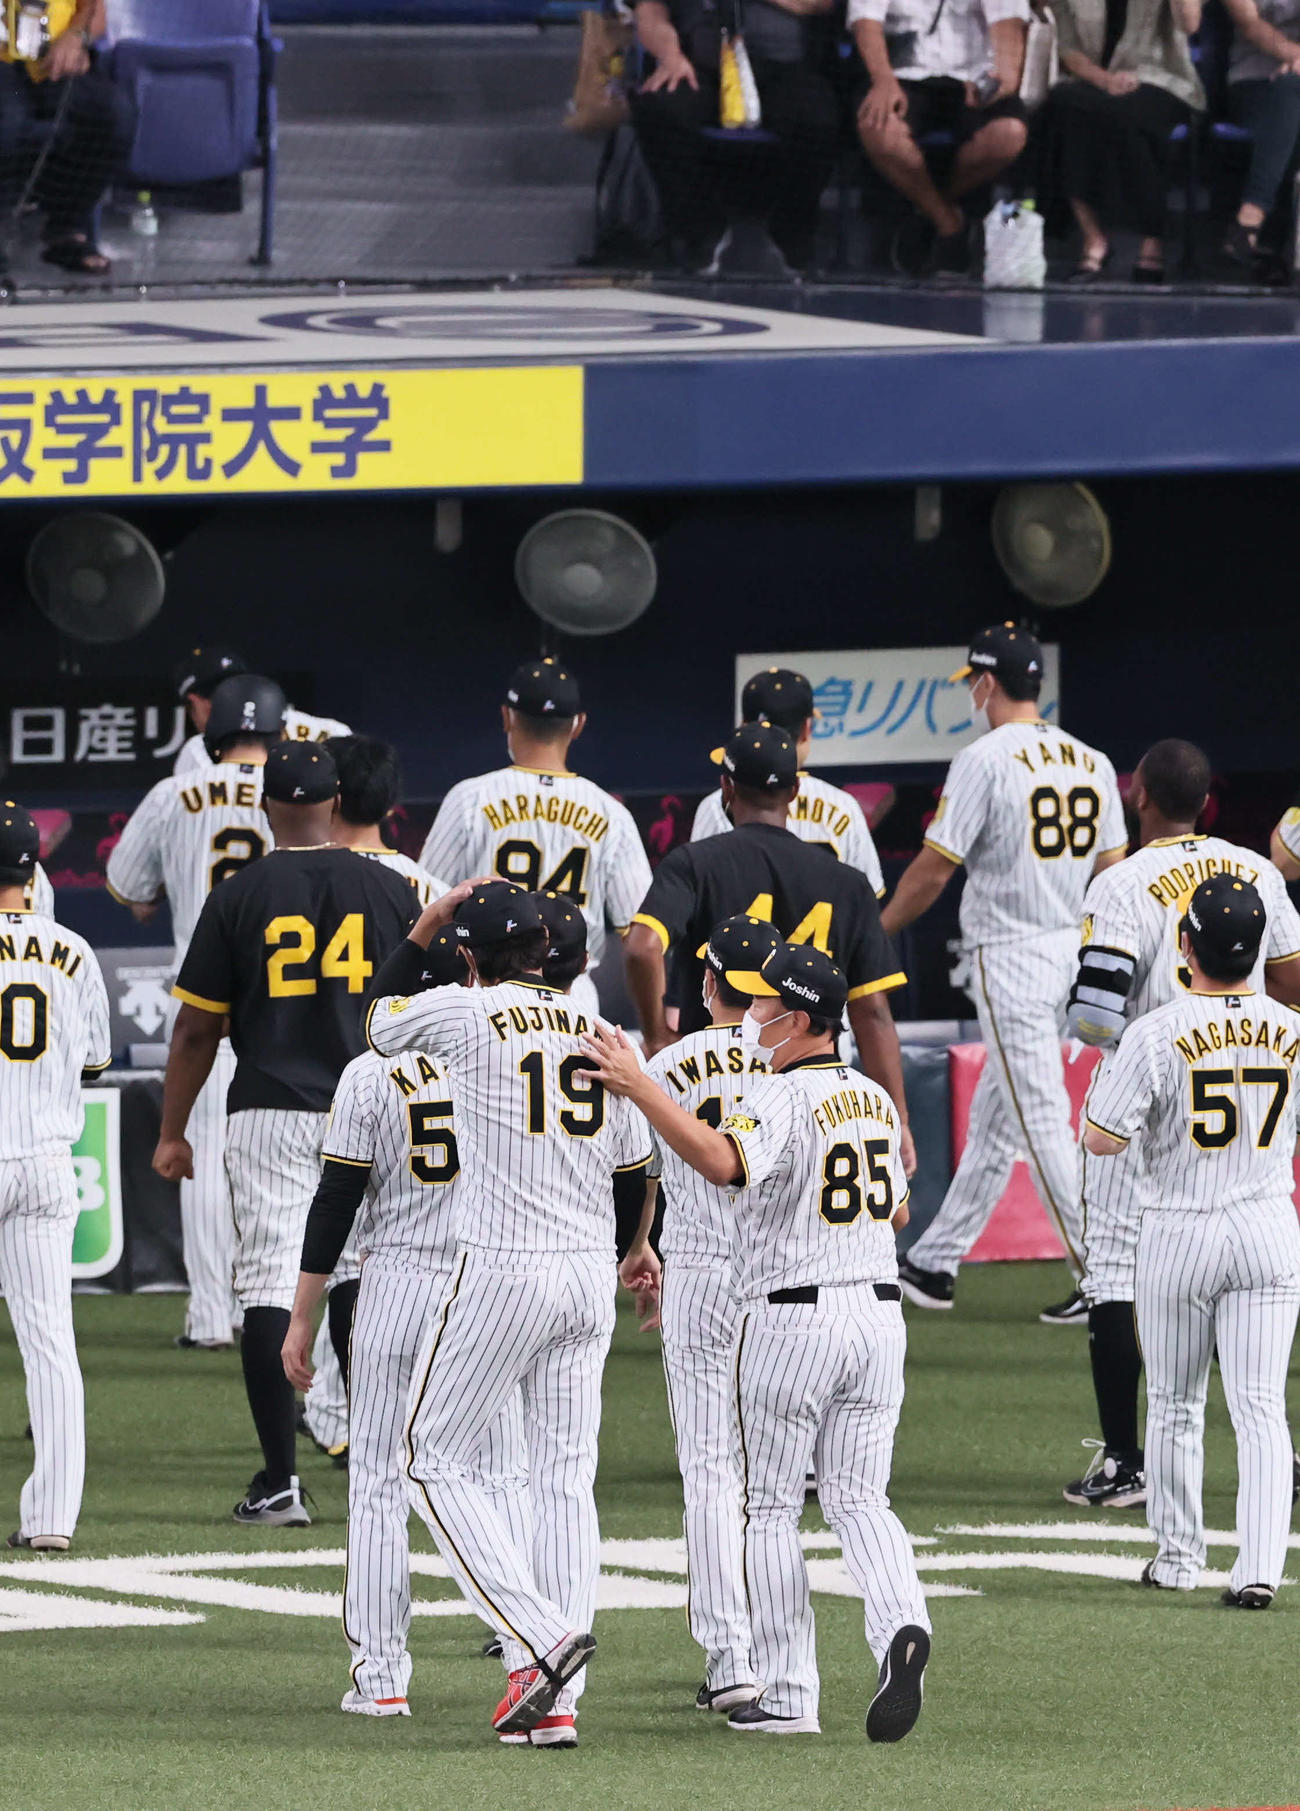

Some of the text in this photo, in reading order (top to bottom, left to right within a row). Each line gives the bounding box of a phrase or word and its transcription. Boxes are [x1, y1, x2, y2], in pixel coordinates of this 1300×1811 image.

[11, 703, 187, 764] 日産リ
[1013, 741, 1096, 775] YANO
[181, 781, 265, 814] UME
[482, 795, 609, 842] HARAGUCHI
[785, 794, 850, 837] MOTO
[1030, 786, 1101, 859] 88
[210, 826, 267, 890] 2
[495, 838, 590, 907] 94
[264, 913, 373, 998] 24
[781, 976, 821, 1003] Joshin
[0, 983, 47, 1063] 0
[489, 1006, 602, 1042] FUJINA
[1176, 1018, 1300, 1064] NAGASAKA
[390, 1055, 450, 1098] KA
[518, 1050, 606, 1138] 19
[664, 1047, 774, 1094] IWASA
[813, 1090, 895, 1136] FUKUHARA
[1190, 1067, 1290, 1150] 57
[407, 1100, 461, 1185] 5
[818, 1138, 896, 1226] 85
